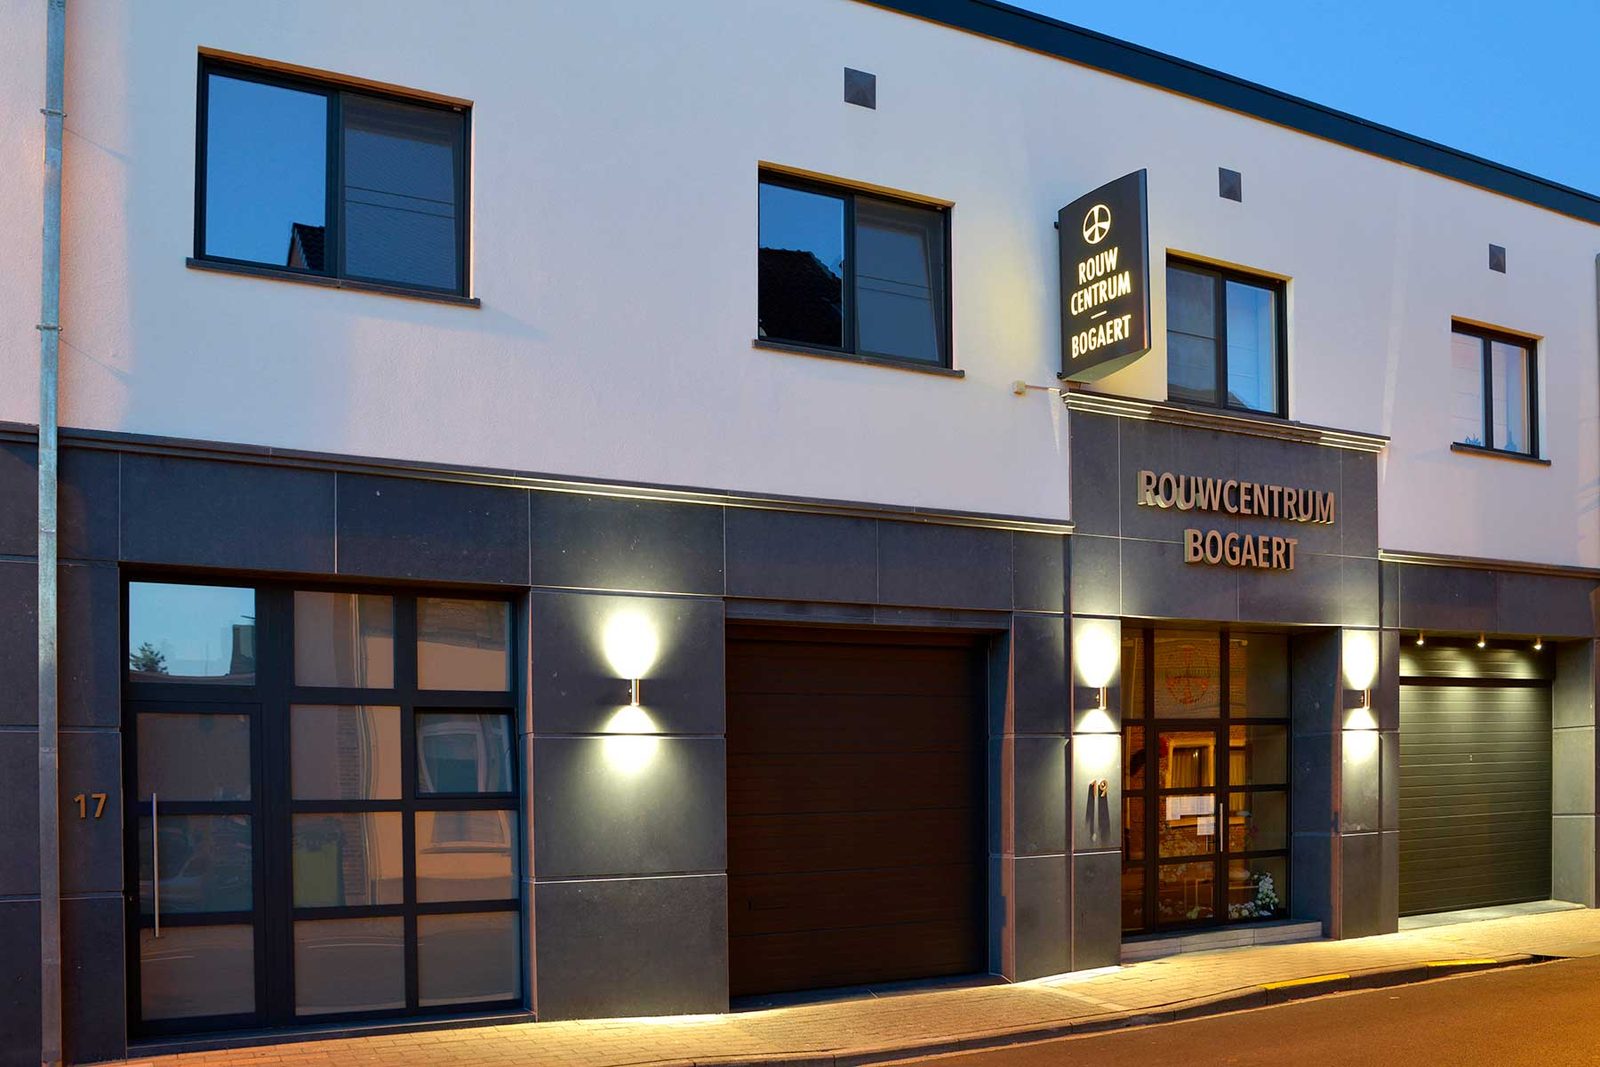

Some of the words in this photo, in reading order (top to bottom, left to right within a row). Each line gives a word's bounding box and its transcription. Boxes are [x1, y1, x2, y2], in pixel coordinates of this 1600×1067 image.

[1078, 247, 1118, 285] ROUW
[1071, 270, 1131, 316] CENTRUM
[1072, 314, 1131, 359] BOGAERT
[1137, 470, 1335, 525] ROUWCENTRUM
[1184, 528, 1298, 570] BOGAERT
[73, 792, 107, 818] 17
[1090, 778, 1108, 798] 19
